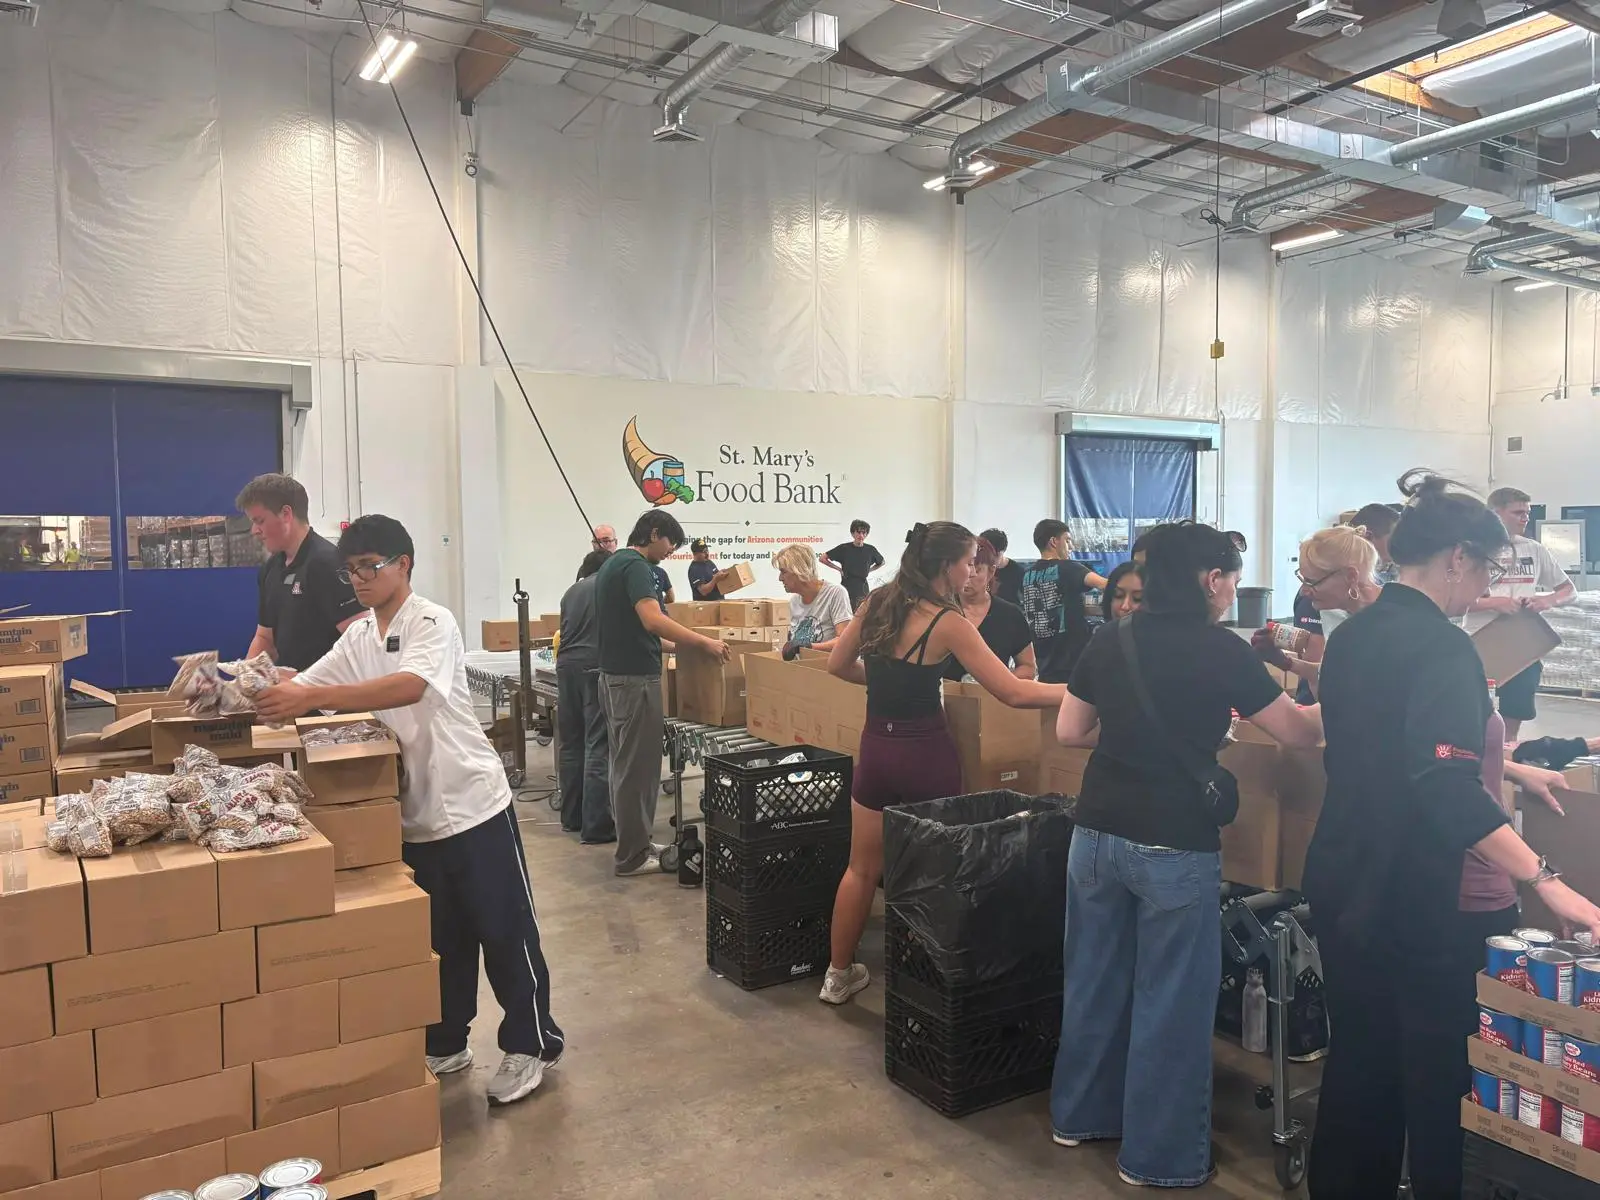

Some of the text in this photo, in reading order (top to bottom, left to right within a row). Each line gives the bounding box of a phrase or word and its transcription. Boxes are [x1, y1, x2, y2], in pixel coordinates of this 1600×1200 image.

[719, 444, 815, 473] St. Mary's
[695, 470, 842, 504] Food Bank
[703, 535, 716, 544] the
[718, 536, 733, 547] gap
[735, 535, 746, 544] for
[747, 535, 775, 544] Arizona
[776, 535, 824, 544] communities
[719, 551, 731, 560] for
[733, 551, 754, 562] today
[756, 551, 771, 560] and
